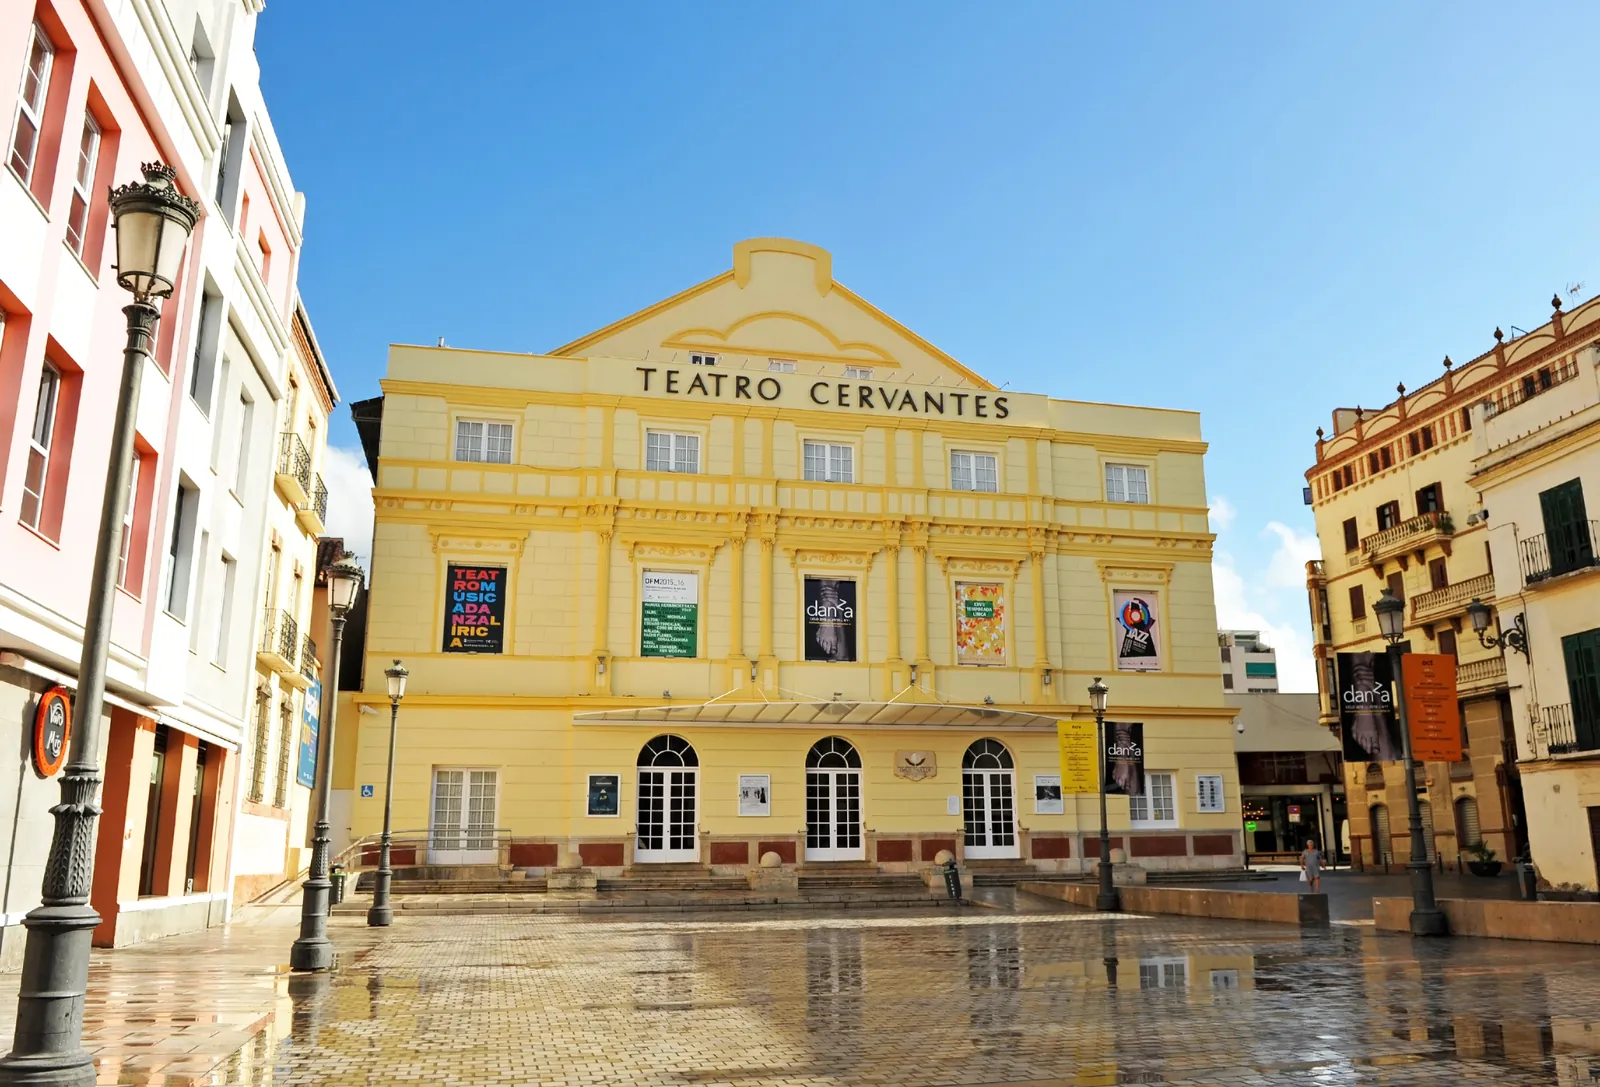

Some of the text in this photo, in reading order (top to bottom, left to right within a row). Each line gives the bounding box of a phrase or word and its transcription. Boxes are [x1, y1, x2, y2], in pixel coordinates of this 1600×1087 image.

[636, 367, 1010, 420] TEATRO CERVANTES
[454, 569, 499, 580] TEAT
[454, 581, 496, 591] ROM
[453, 590, 497, 602] ÚSIC
[452, 603, 490, 614] ADA
[806, 598, 854, 619] danza
[452, 614, 501, 626] NZAL
[451, 624, 489, 636] ÍRIC
[450, 637, 463, 648] A
[1126, 628, 1150, 645] JAZZ
[1343, 681, 1391, 703] danza
[1107, 741, 1142, 757] danza
